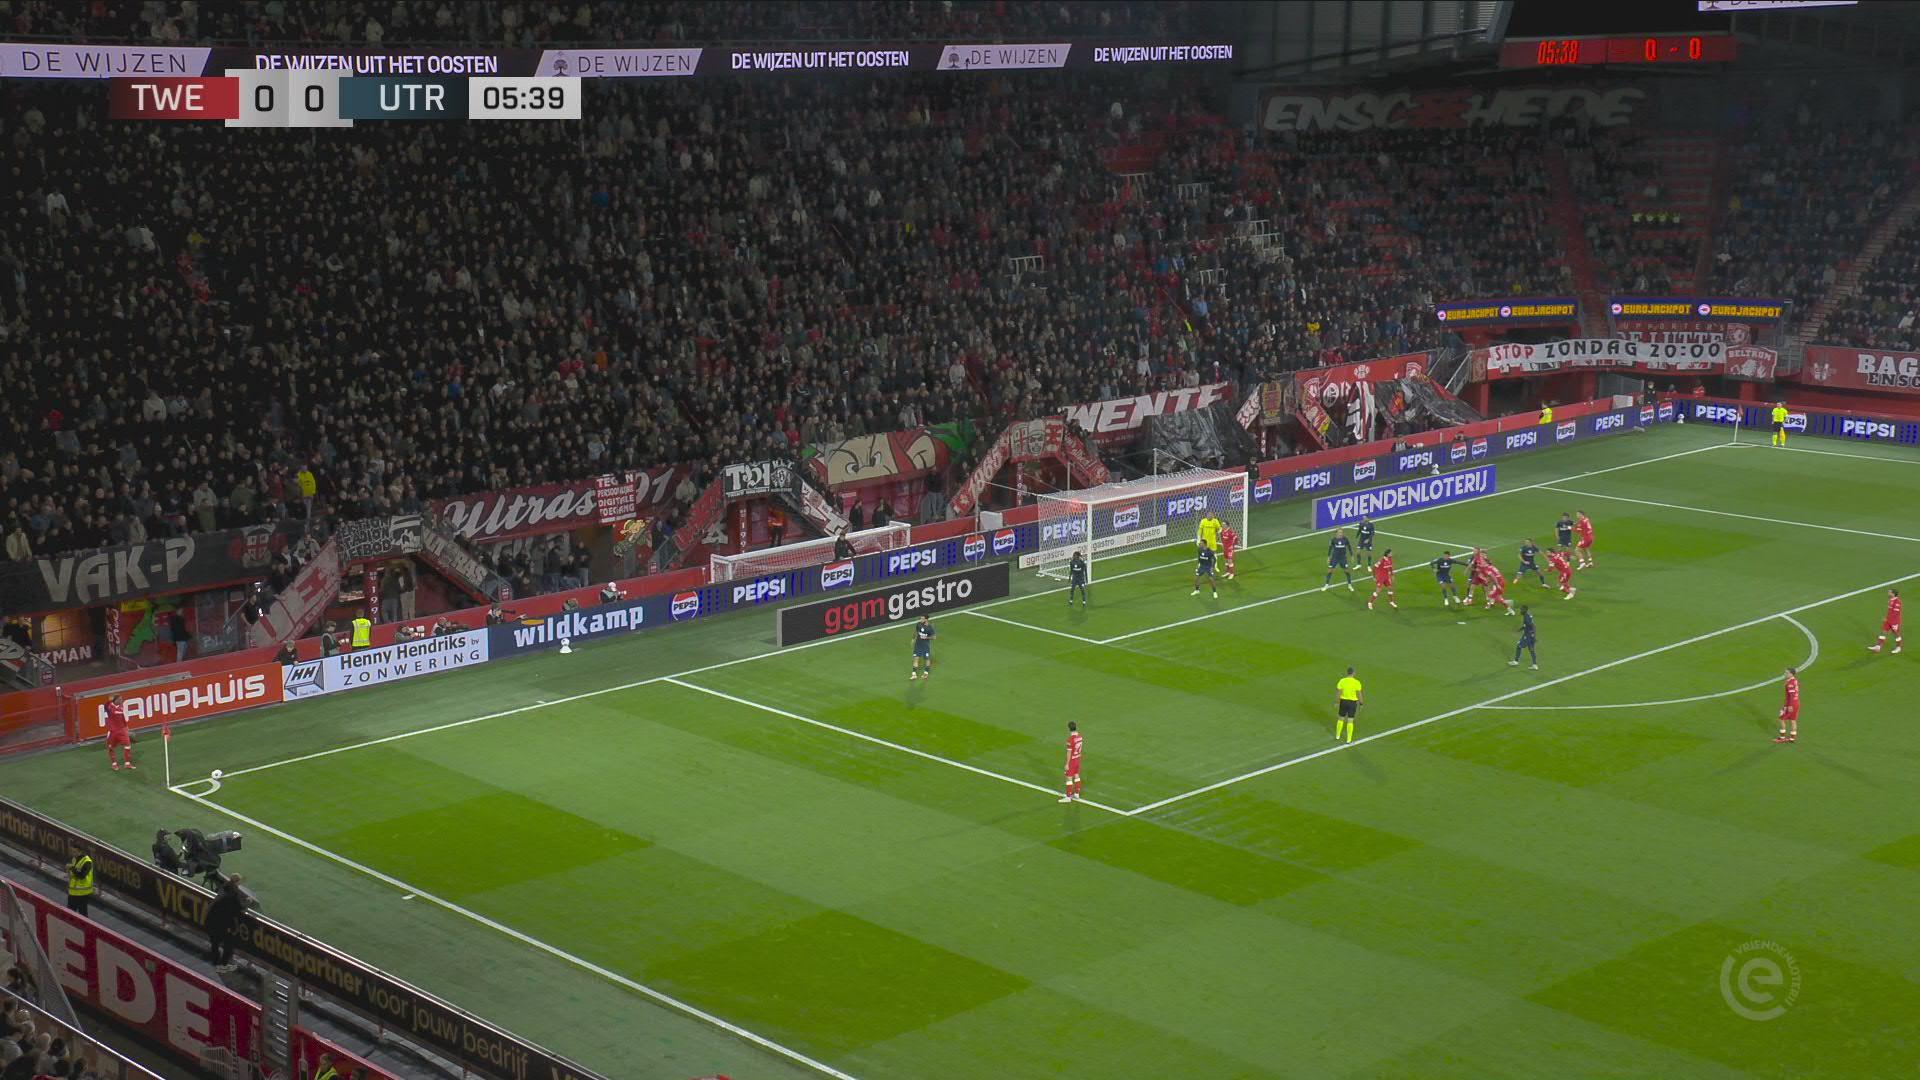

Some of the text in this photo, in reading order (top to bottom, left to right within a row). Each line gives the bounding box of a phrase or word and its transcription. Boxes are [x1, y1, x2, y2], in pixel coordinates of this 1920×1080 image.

[971, 49, 1057, 65] DE WIJZEN
[1094, 45, 1232, 64] DE WIJZEN UIT HET OOSTEN
[1537, 41, 1579, 65] 05:38
[1645, 39, 1657, 61] 0
[1690, 38, 1700, 60] 0
[22, 51, 186, 73] DE WIJZEN
[256, 55, 281, 70] DE
[357, 55, 387, 73] UIT
[390, 55, 424, 73] HET
[427, 55, 498, 73] OOSTEN
[578, 55, 691, 73] DE WIJZEN
[732, 51, 909, 71] DE WIJZEN UIT HET OOSTEN
[1446, 307, 1499, 320] EUROJACKPOT
[1511, 305, 1575, 317] EUROJACKPOT
[1623, 304, 1691, 315] EUROJACKPOT
[1711, 306, 1782, 317] EUROJACKPOT
[1495, 340, 1720, 361] STOP ZONDAG 20:00
[1595, 413, 1624, 431] PEPSI
[1843, 419, 1895, 438] PEPSI
[1506, 431, 1537, 449] PEPSI
[1400, 452, 1433, 471] PEPSI
[596, 473, 634, 488] TEGN
[1354, 465, 1376, 478] PEPSI
[1254, 485, 1272, 496] PEPSI
[1294, 471, 1330, 492] PEPSI
[1327, 470, 1488, 521] VRIENDENLOTERIJ
[444, 489, 597, 538] Ultras
[1167, 496, 1208, 516] PEPSI
[1115, 511, 1139, 525] PEPSI
[964, 542, 985, 554] PEPSI
[994, 537, 1016, 548] PEPSI
[889, 549, 937, 572] PEPSI
[37, 537, 195, 605] VAK-P
[823, 568, 853, 583] PEPSI
[733, 578, 787, 604] PEPSI
[673, 600, 698, 612] PEPSI
[824, 579, 973, 635] ggmgastro
[513, 606, 644, 648] wildkamp
[341, 649, 392, 670] Henny
[397, 636, 466, 660] Hendriks
[291, 666, 316, 682] HH
[343, 650, 480, 686] ZONWERING
[253, 929, 364, 993] datapartner
[366, 980, 409, 1017] voor
[411, 1000, 458, 1043] jouw
[463, 1031, 529, 1080] bedrijf
